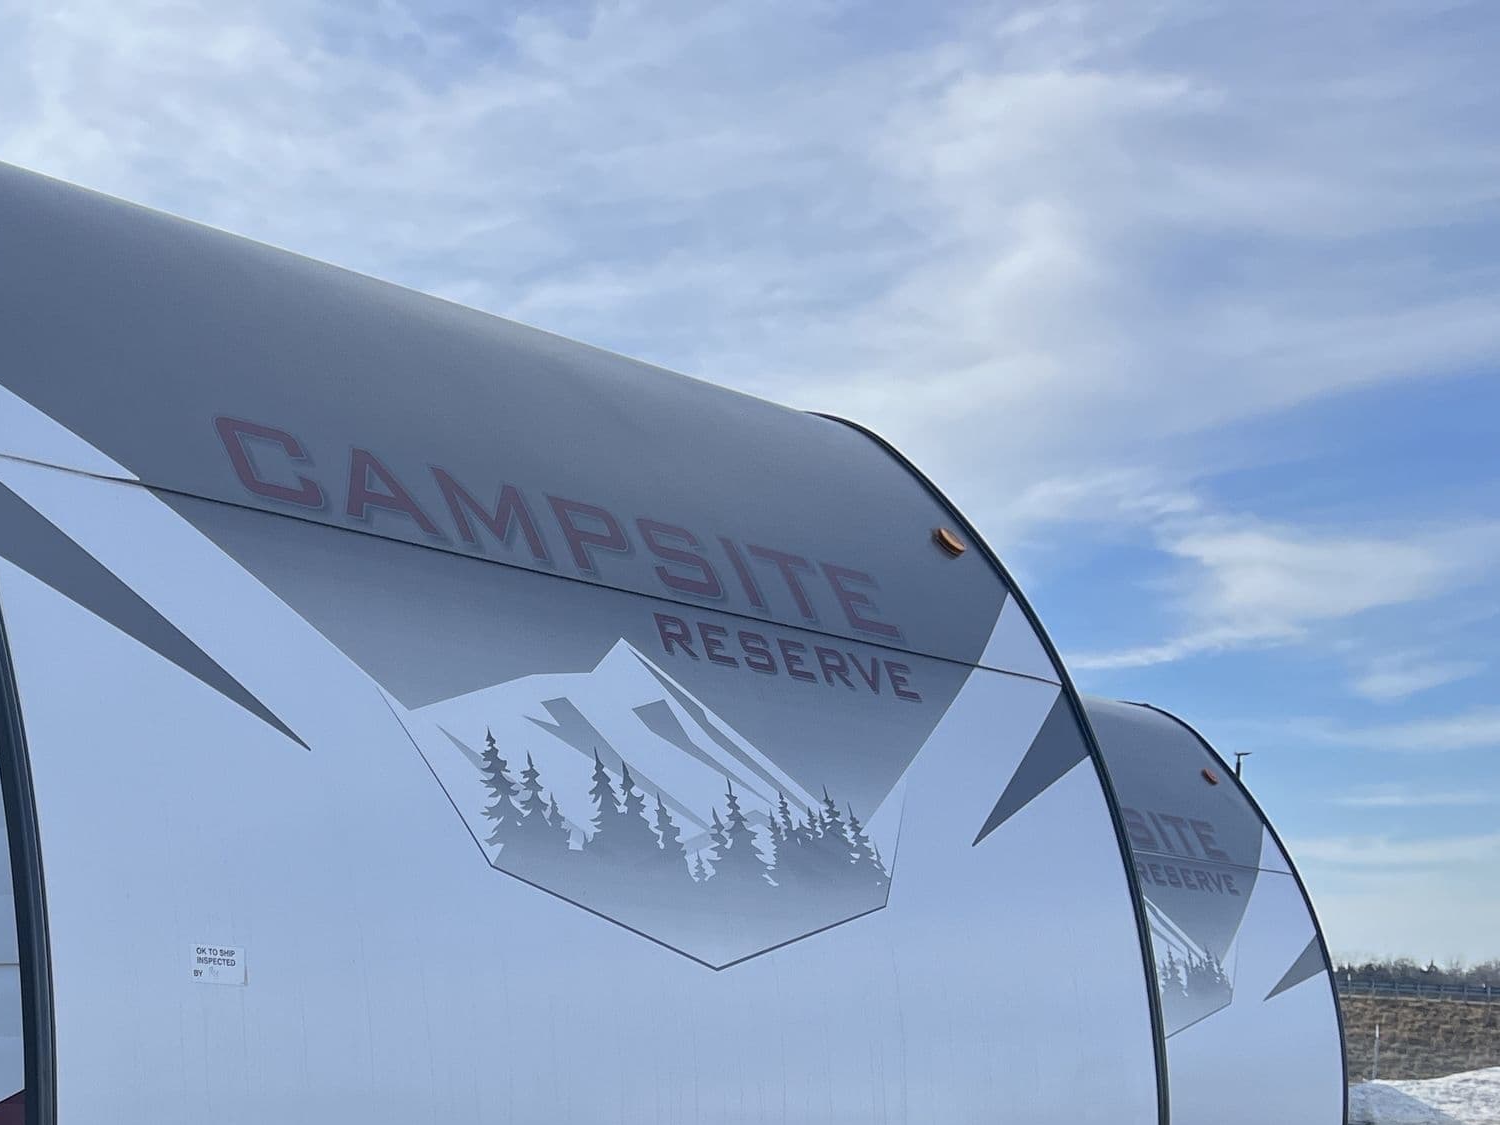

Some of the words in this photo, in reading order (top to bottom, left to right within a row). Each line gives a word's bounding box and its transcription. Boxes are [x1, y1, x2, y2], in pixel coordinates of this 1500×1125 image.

[213, 416, 902, 640] CAMPSITE
[652, 612, 922, 701] RESERVE
[196, 947, 206, 955] OK
[208, 948, 218, 956] TO
[219, 949, 235, 957] SHIP
[196, 956, 236, 967] INSPECTED
[193, 969, 203, 977] BY
